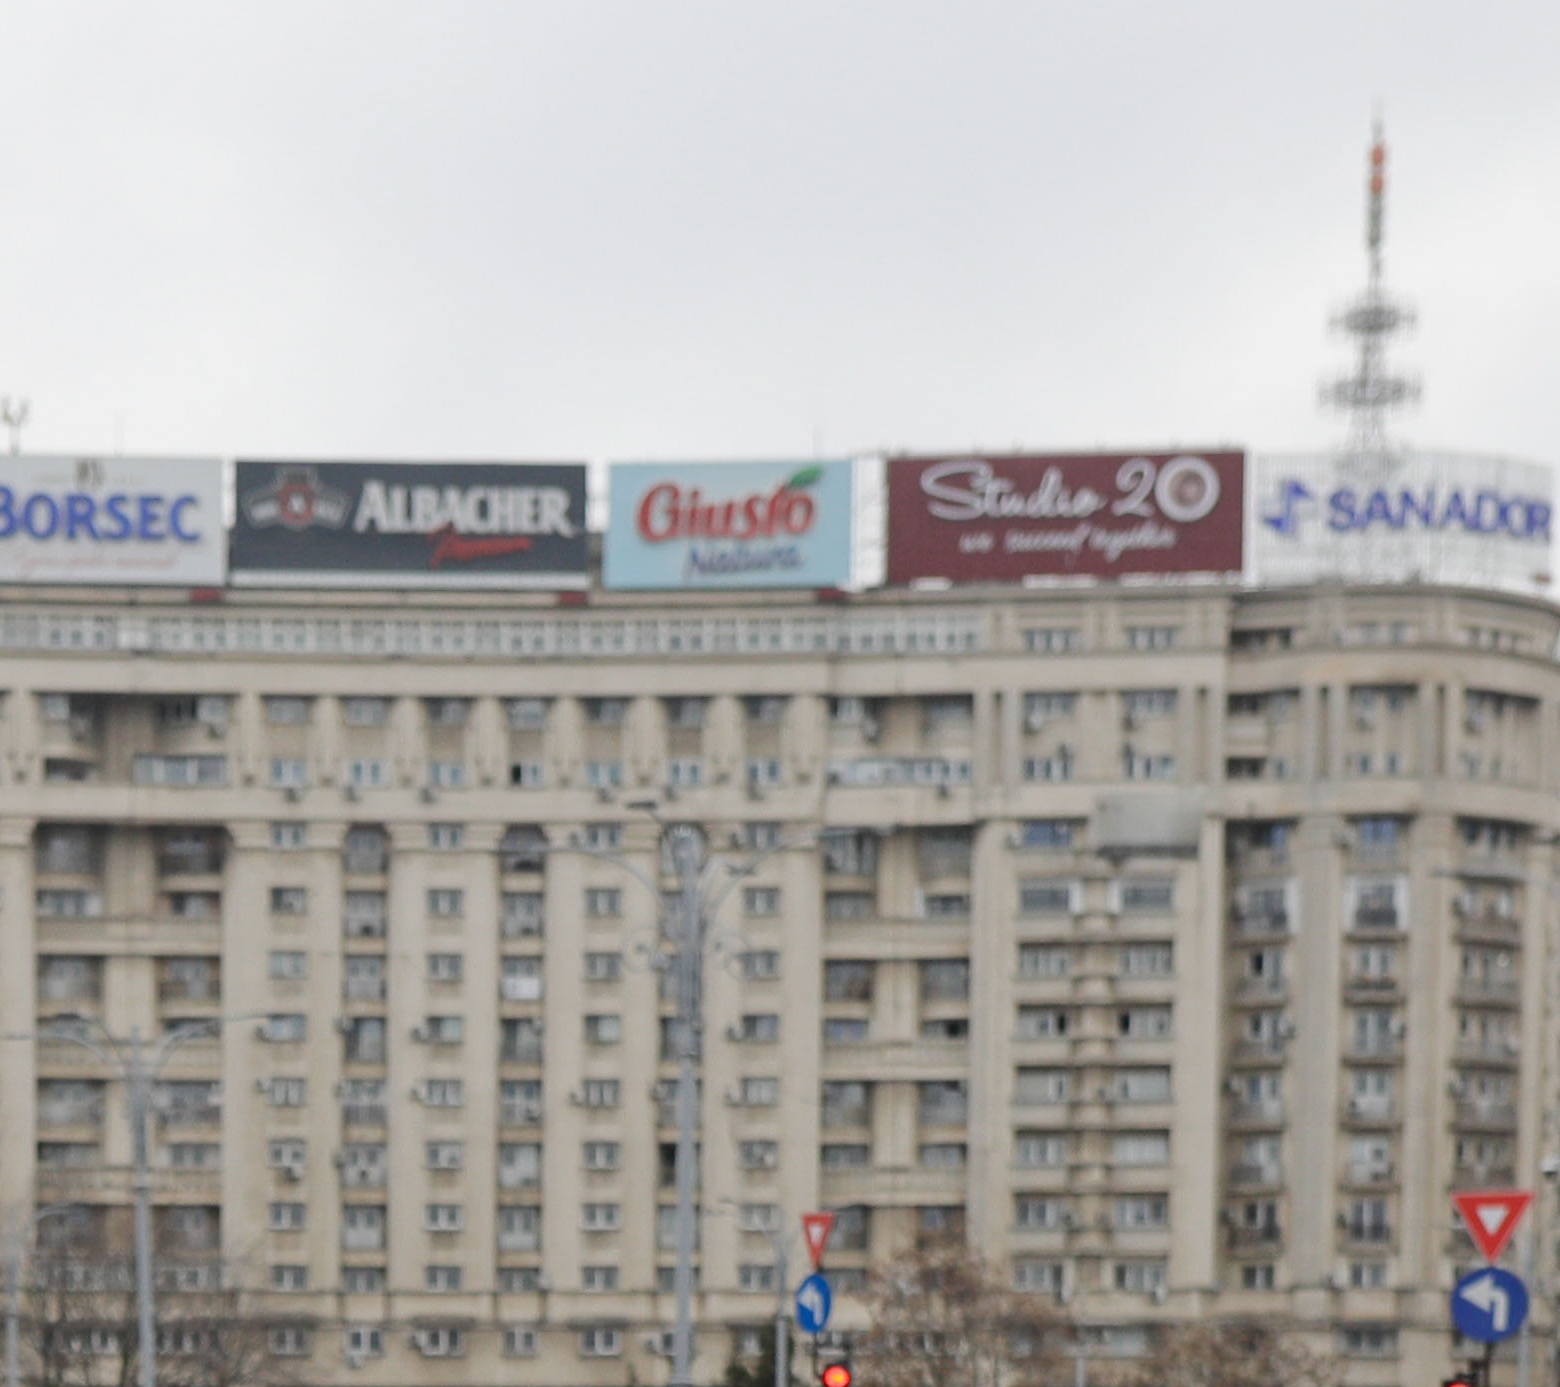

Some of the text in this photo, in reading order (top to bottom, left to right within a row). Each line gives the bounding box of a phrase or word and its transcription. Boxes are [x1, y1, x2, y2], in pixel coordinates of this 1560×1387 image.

[633, 482, 815, 542] Giusto
[919, 454, 1221, 523] Studio 20
[1328, 487, 1552, 545] SANADOR
